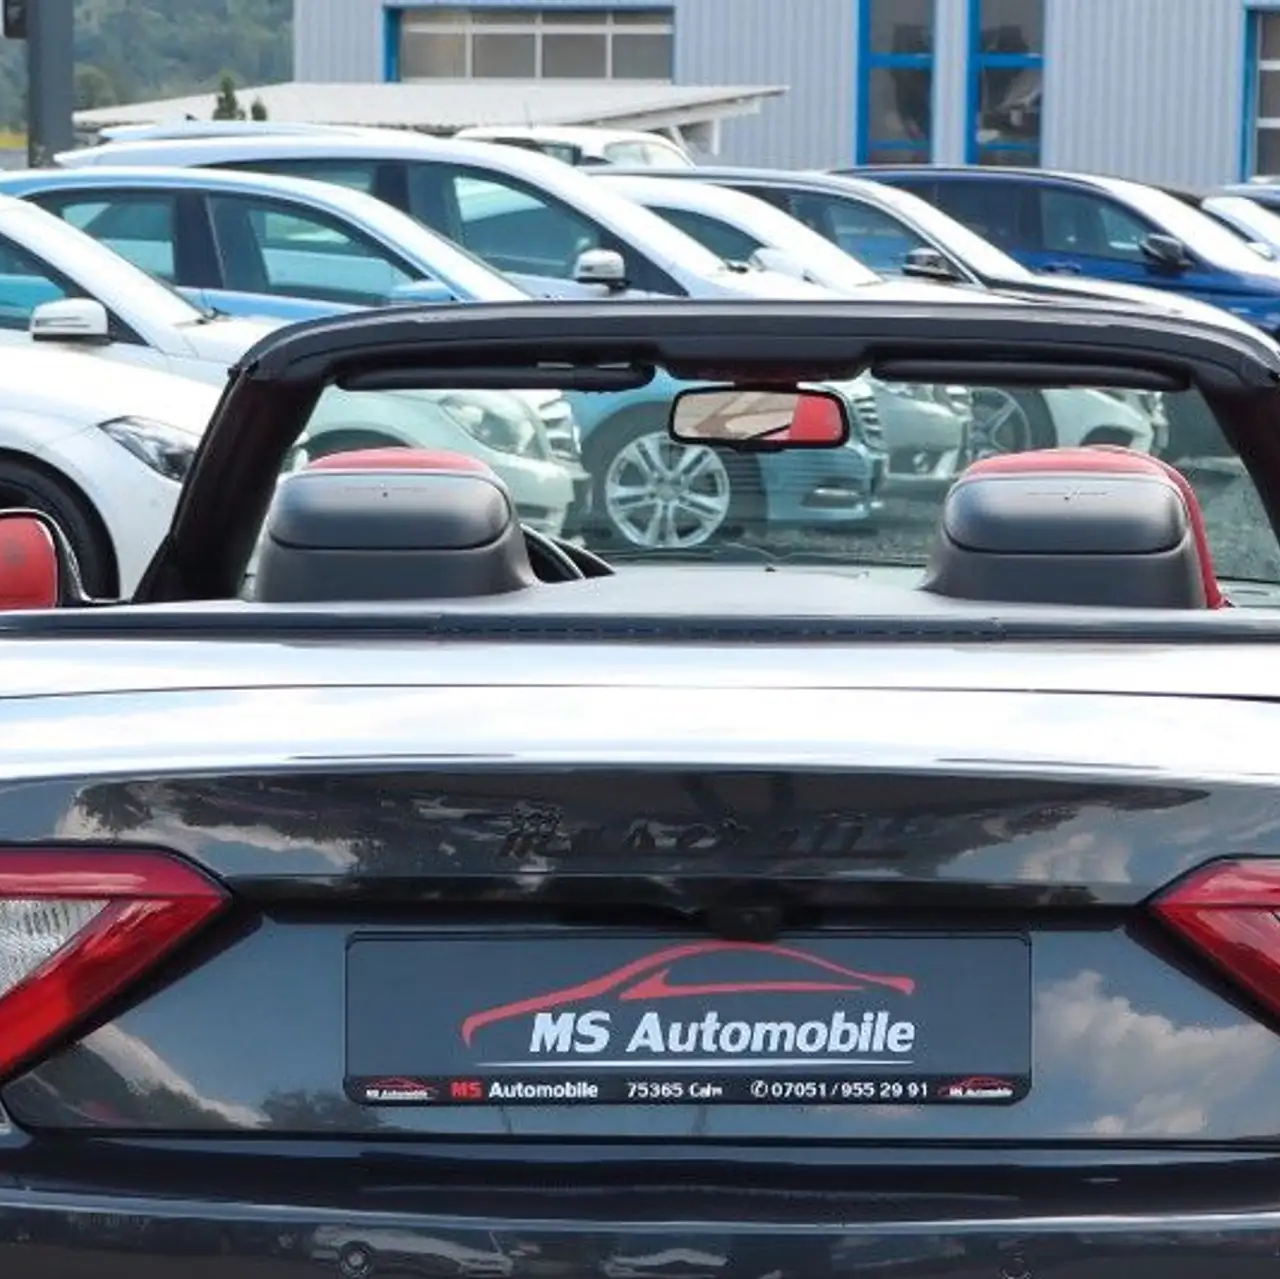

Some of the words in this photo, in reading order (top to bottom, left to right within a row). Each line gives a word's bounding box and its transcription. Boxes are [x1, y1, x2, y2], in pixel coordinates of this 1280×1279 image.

[530, 1011, 611, 1053] MS
[626, 1011, 915, 1053] Automobile
[451, 1081, 482, 1098] MS
[488, 1081, 598, 1098] Automobile
[628, 1082, 684, 1098] 75365
[770, 1082, 827, 1098] 07051
[841, 1082, 875, 1098] 955
[880, 1082, 903, 1098] 29
[907, 1082, 928, 1098] 91
